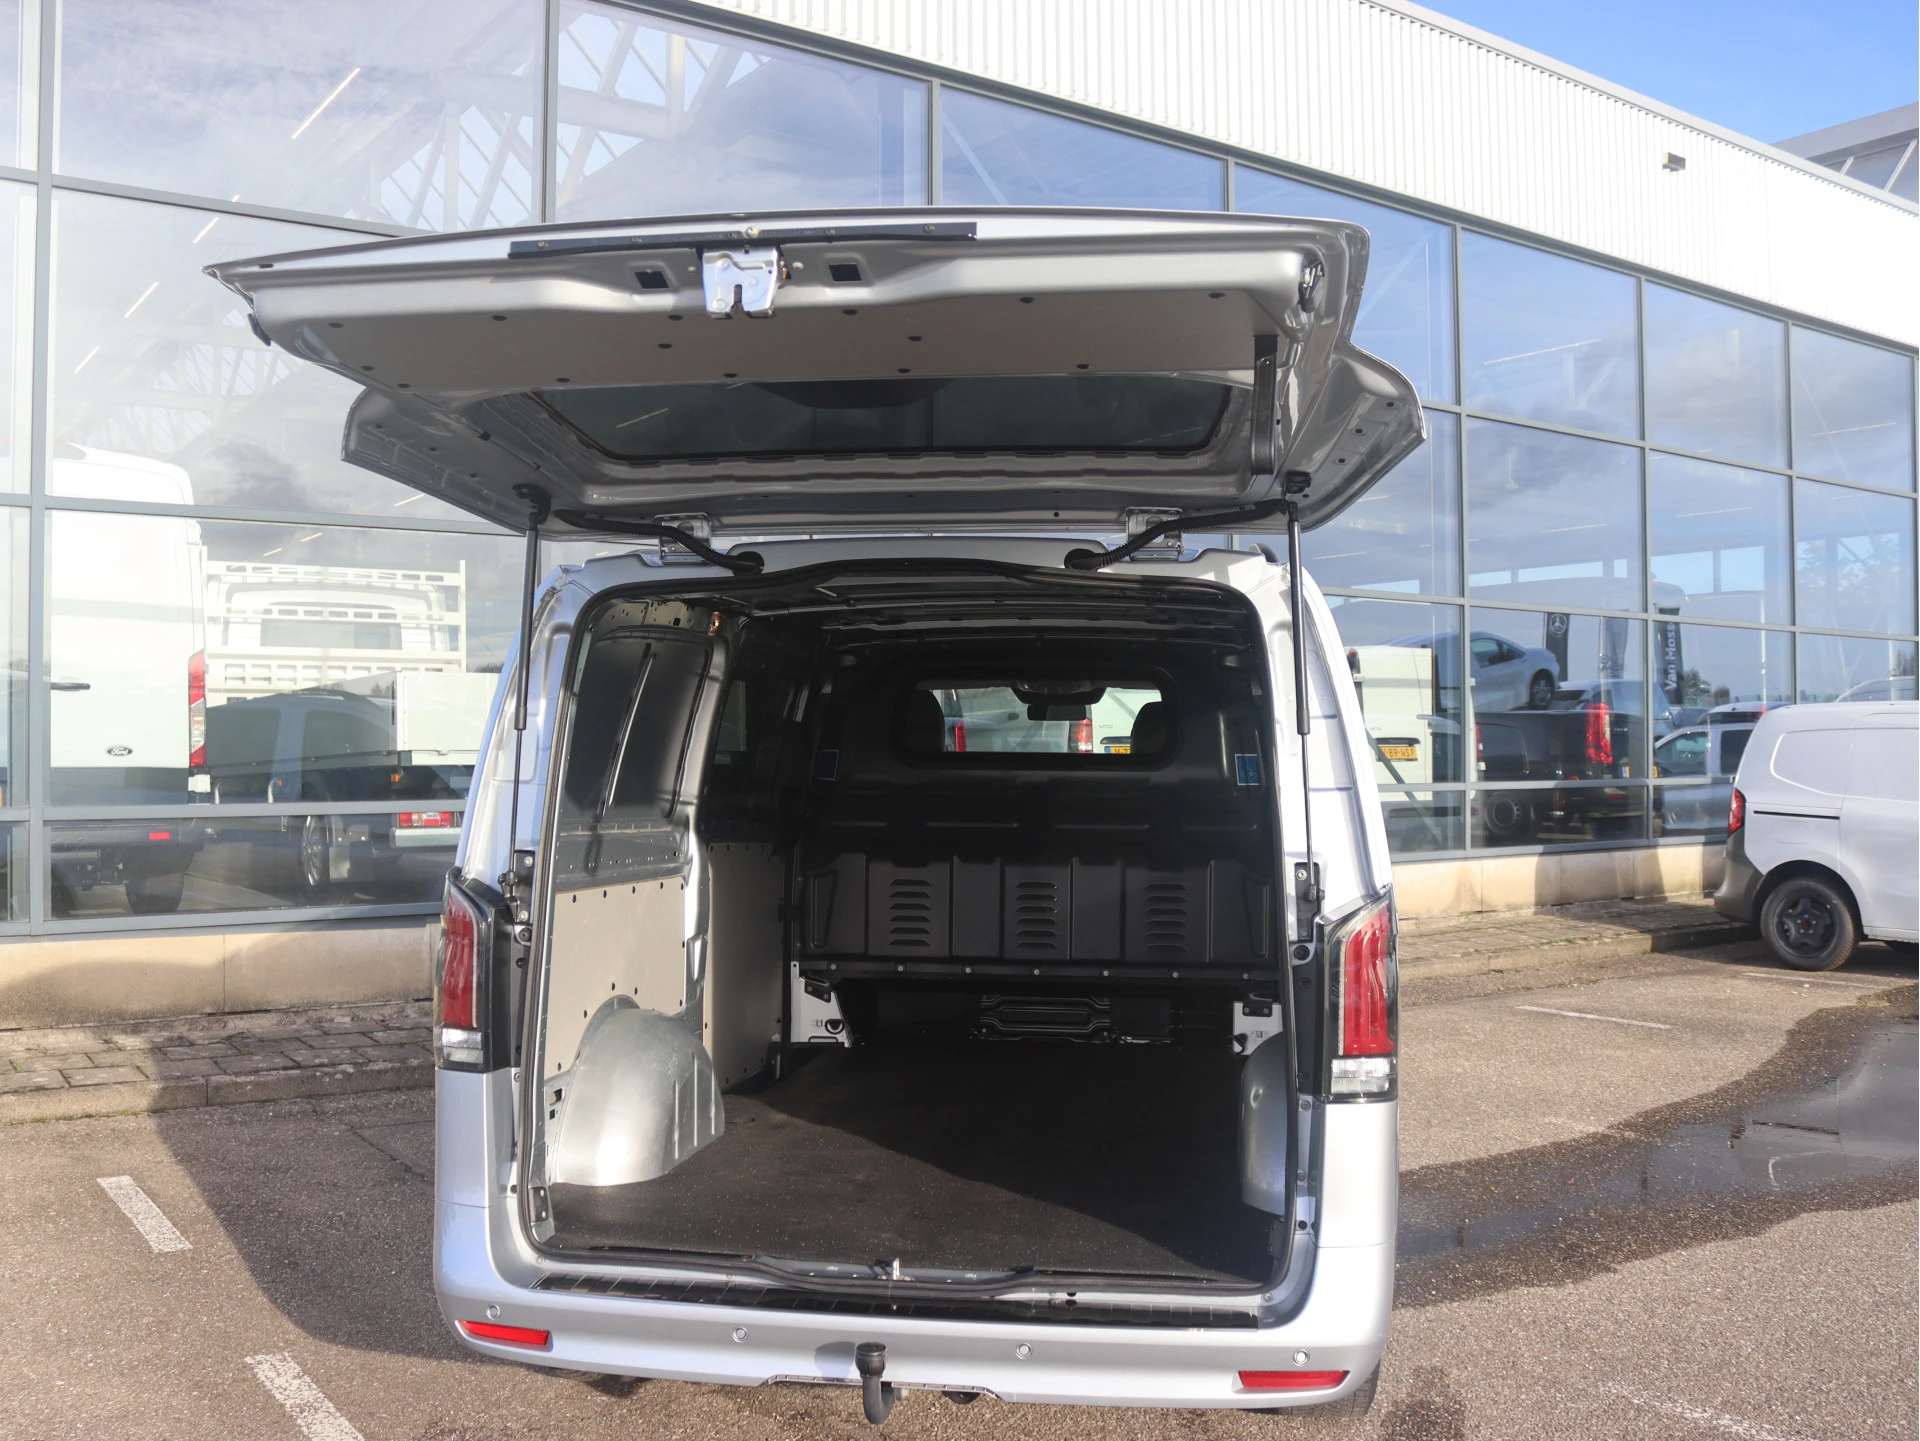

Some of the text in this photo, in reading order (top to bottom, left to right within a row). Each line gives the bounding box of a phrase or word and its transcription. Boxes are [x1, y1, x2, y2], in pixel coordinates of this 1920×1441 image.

[1664, 622, 1678, 690] Van Moss
[109, 747, 130, 755] Ford
